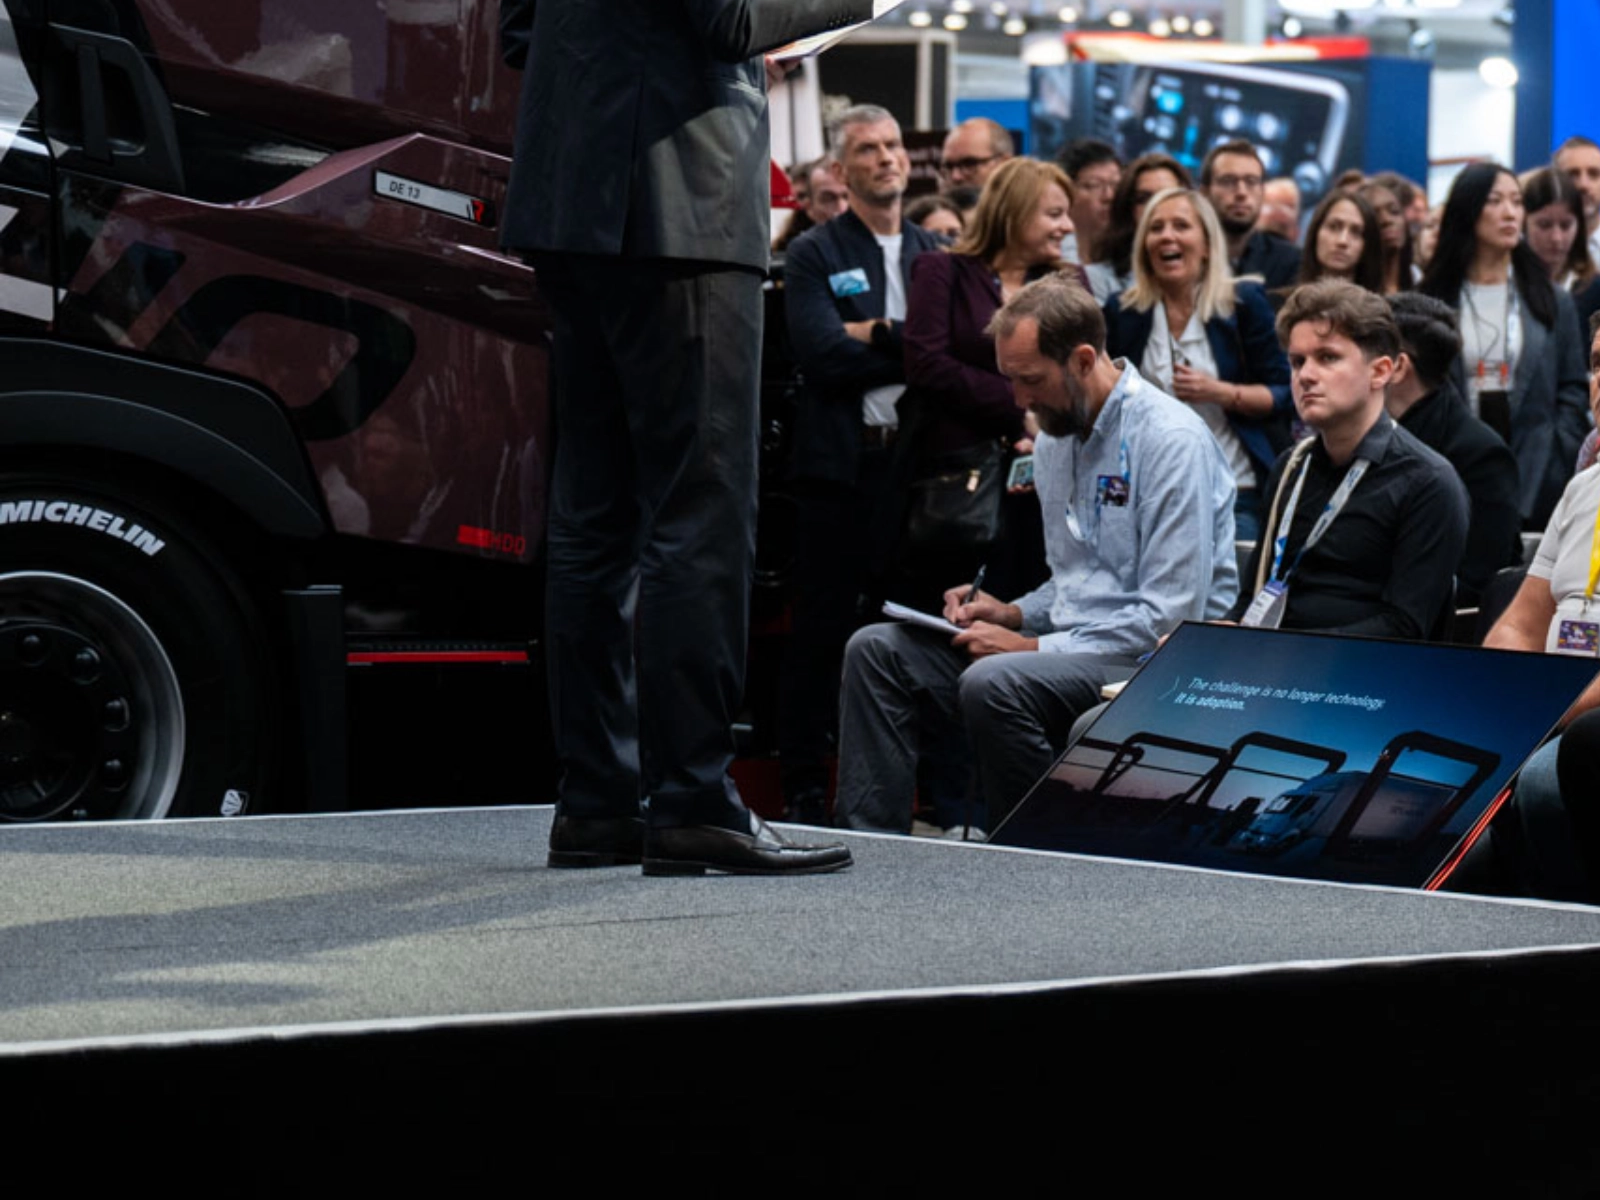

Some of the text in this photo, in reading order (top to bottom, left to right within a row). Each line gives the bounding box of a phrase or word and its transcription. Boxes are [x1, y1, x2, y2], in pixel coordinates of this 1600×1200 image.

[389, 180, 421, 200] DE 13
[0, 500, 166, 557] MICHELIN
[1174, 691, 1187, 704] It
[1185, 693, 1197, 705] is
[1188, 677, 1209, 691] The
[1209, 680, 1261, 699] challenge
[1261, 686, 1273, 697] is
[1273, 689, 1288, 699] no
[1287, 687, 1326, 704] longer
